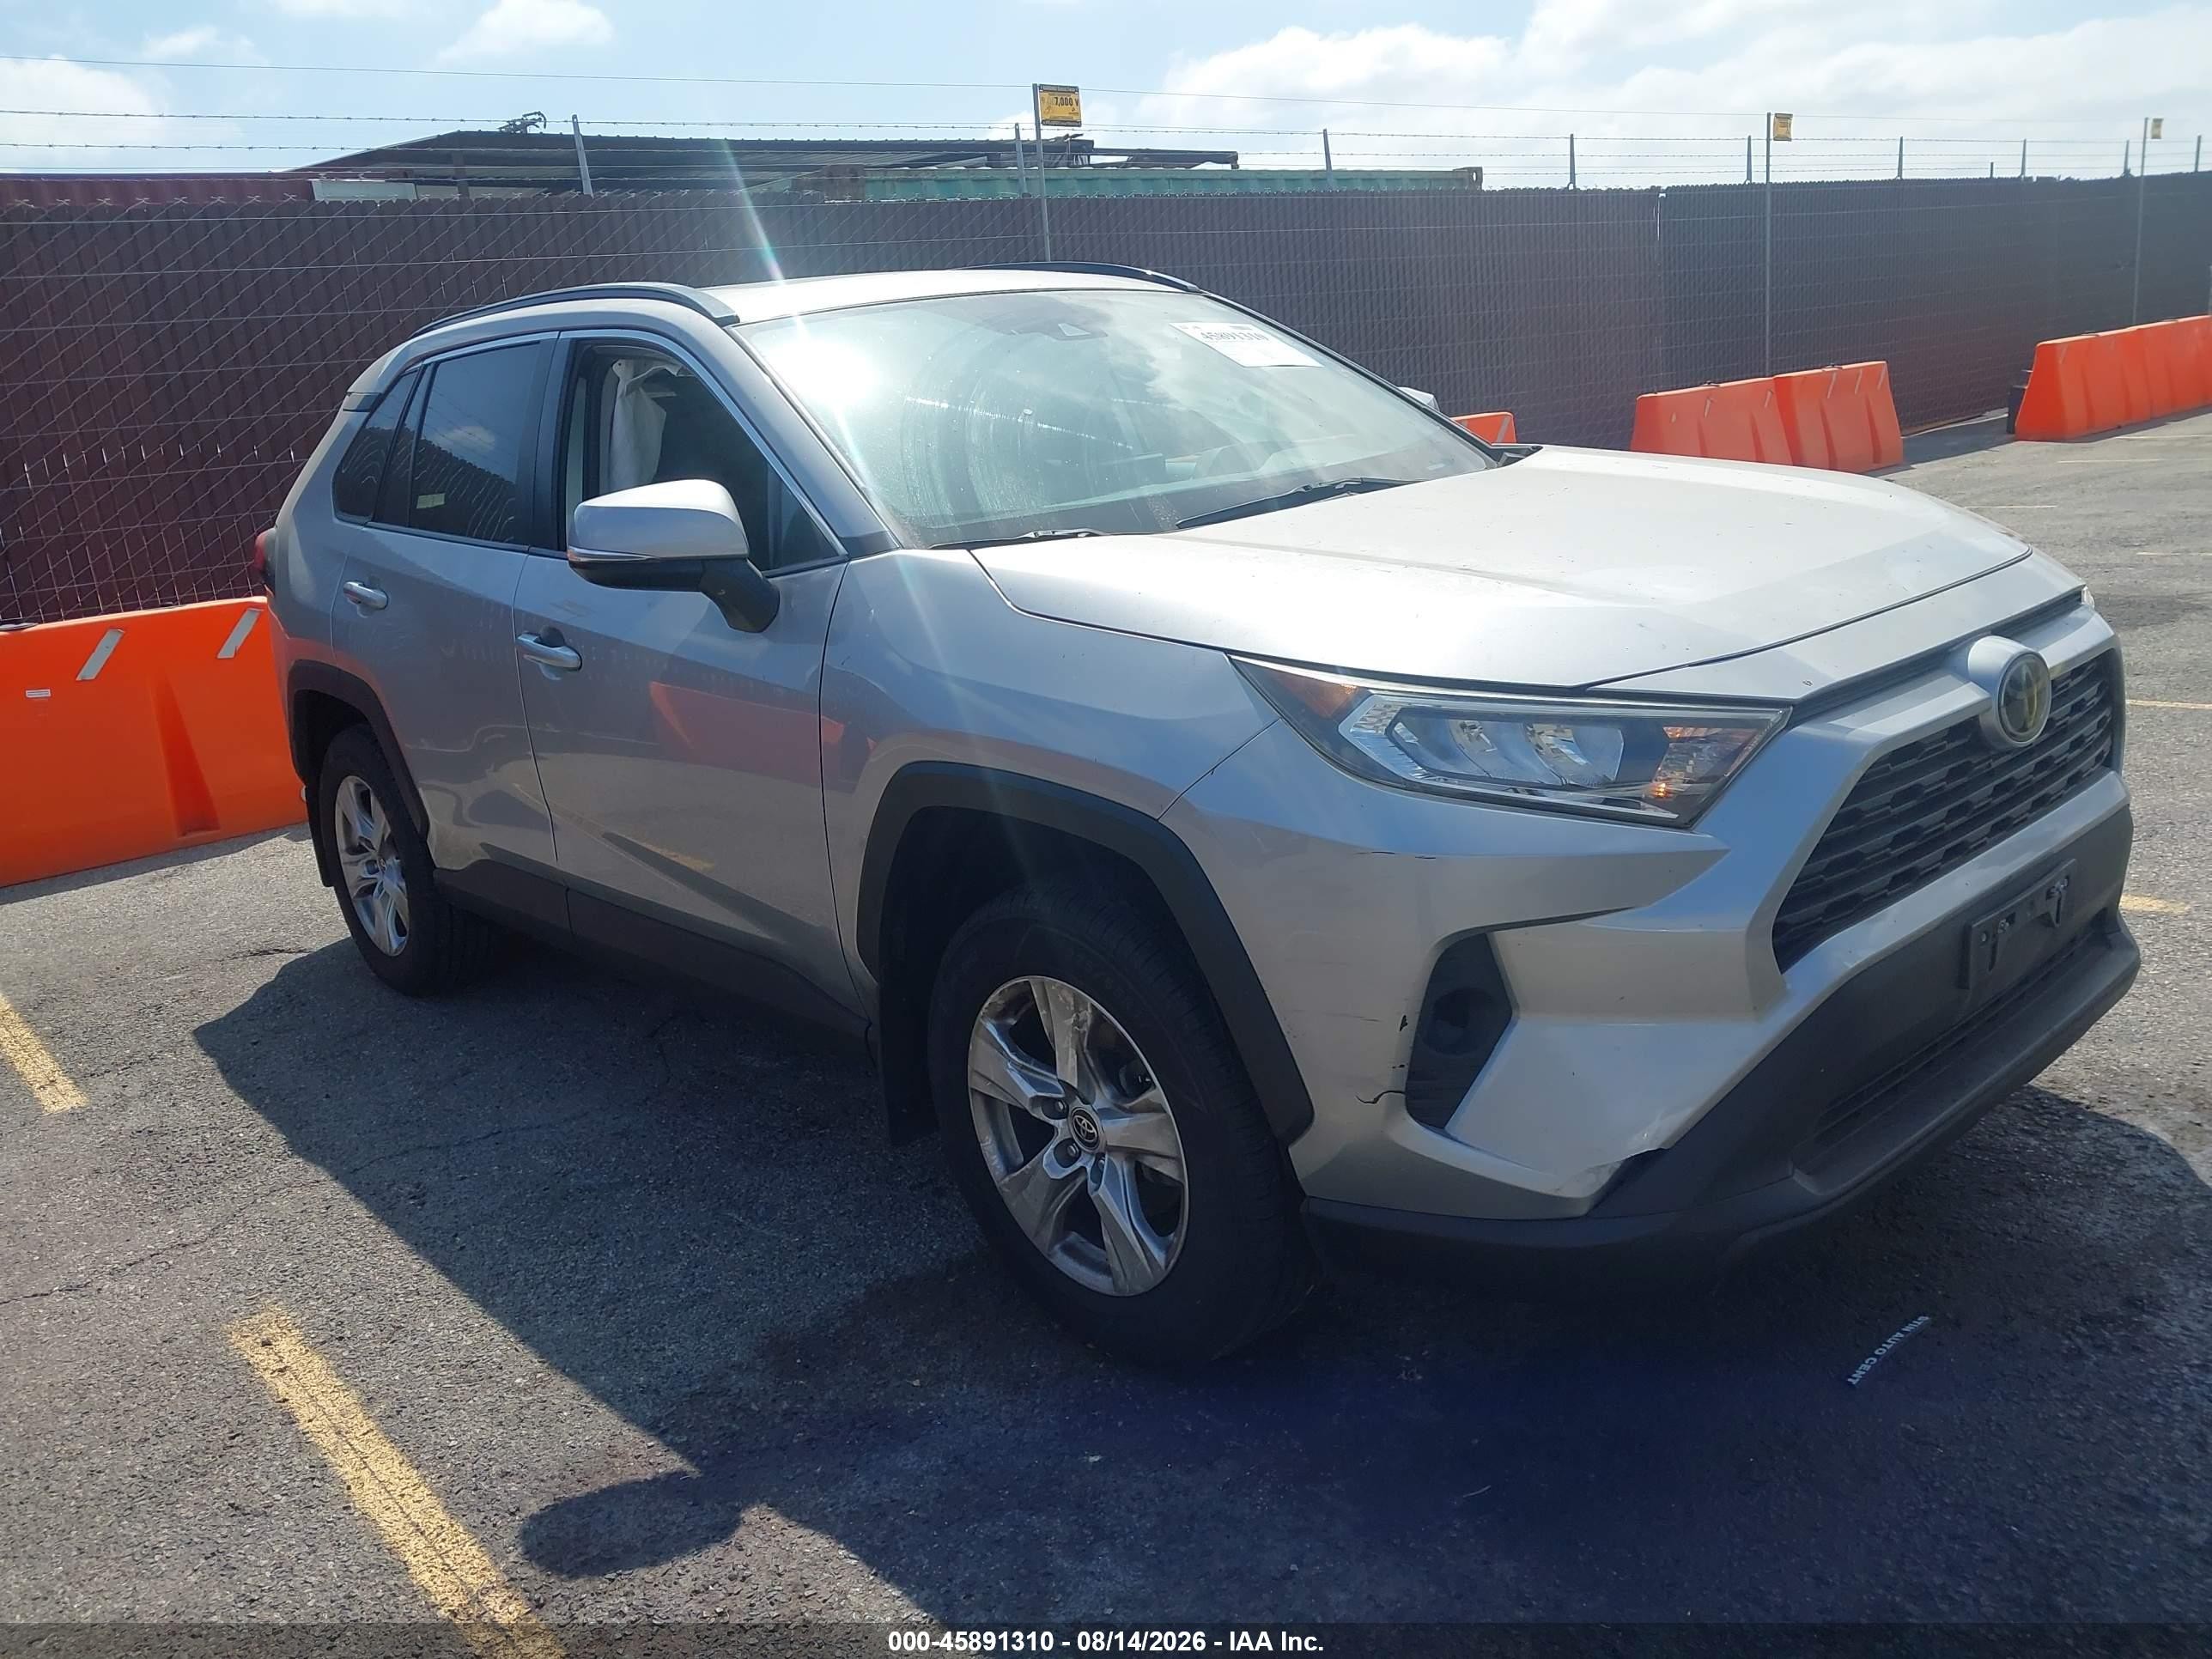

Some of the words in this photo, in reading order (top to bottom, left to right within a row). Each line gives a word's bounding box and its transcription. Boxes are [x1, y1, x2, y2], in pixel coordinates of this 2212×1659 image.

[1054, 96, 1073, 107] 7,000
[1874, 1332, 1905, 1355] AUTO
[1847, 1357, 1878, 1385] CENT
